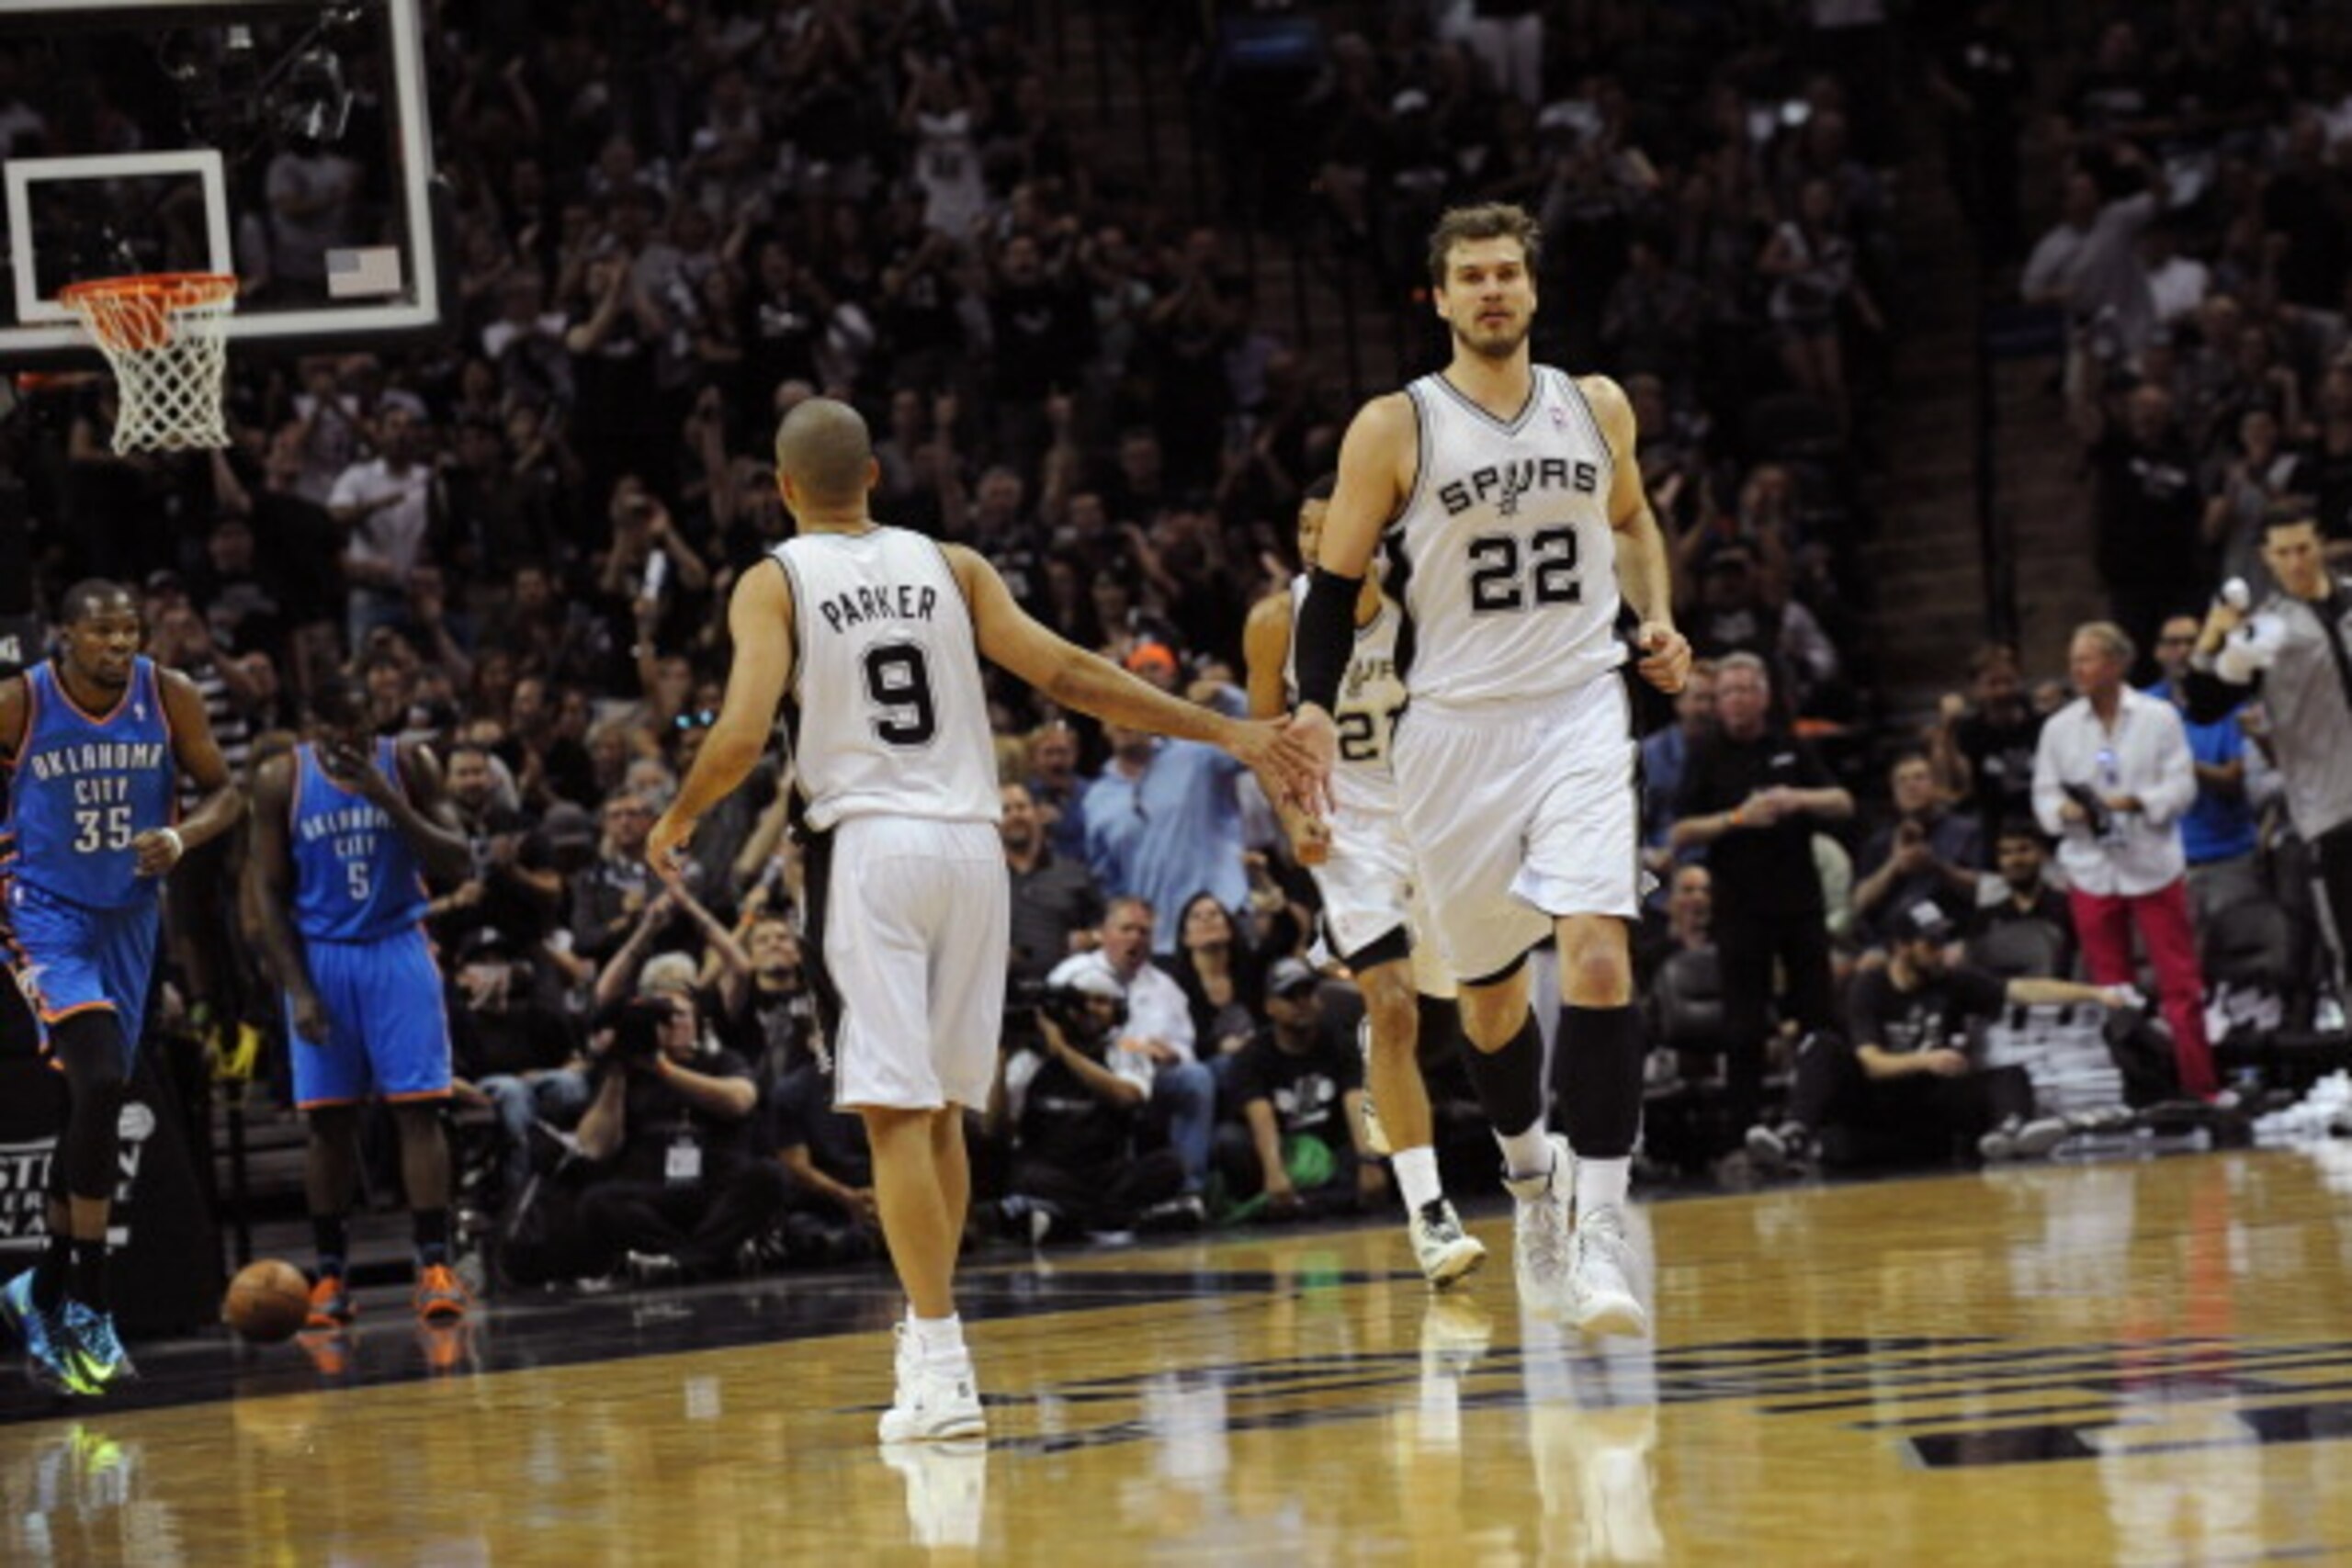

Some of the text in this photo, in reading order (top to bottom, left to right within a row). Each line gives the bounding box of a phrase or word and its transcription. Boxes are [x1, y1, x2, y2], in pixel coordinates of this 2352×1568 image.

[1439, 457, 1597, 516] SPURS
[1468, 525, 1582, 614] 22
[820, 584, 936, 635] PARKER
[863, 641, 936, 746] 9
[31, 742, 164, 781] OKLAHOMA
[74, 776, 129, 806] CITY
[74, 806, 132, 853] 35
[300, 804, 394, 842] OKLAHOM
[347, 861, 369, 901] 5
